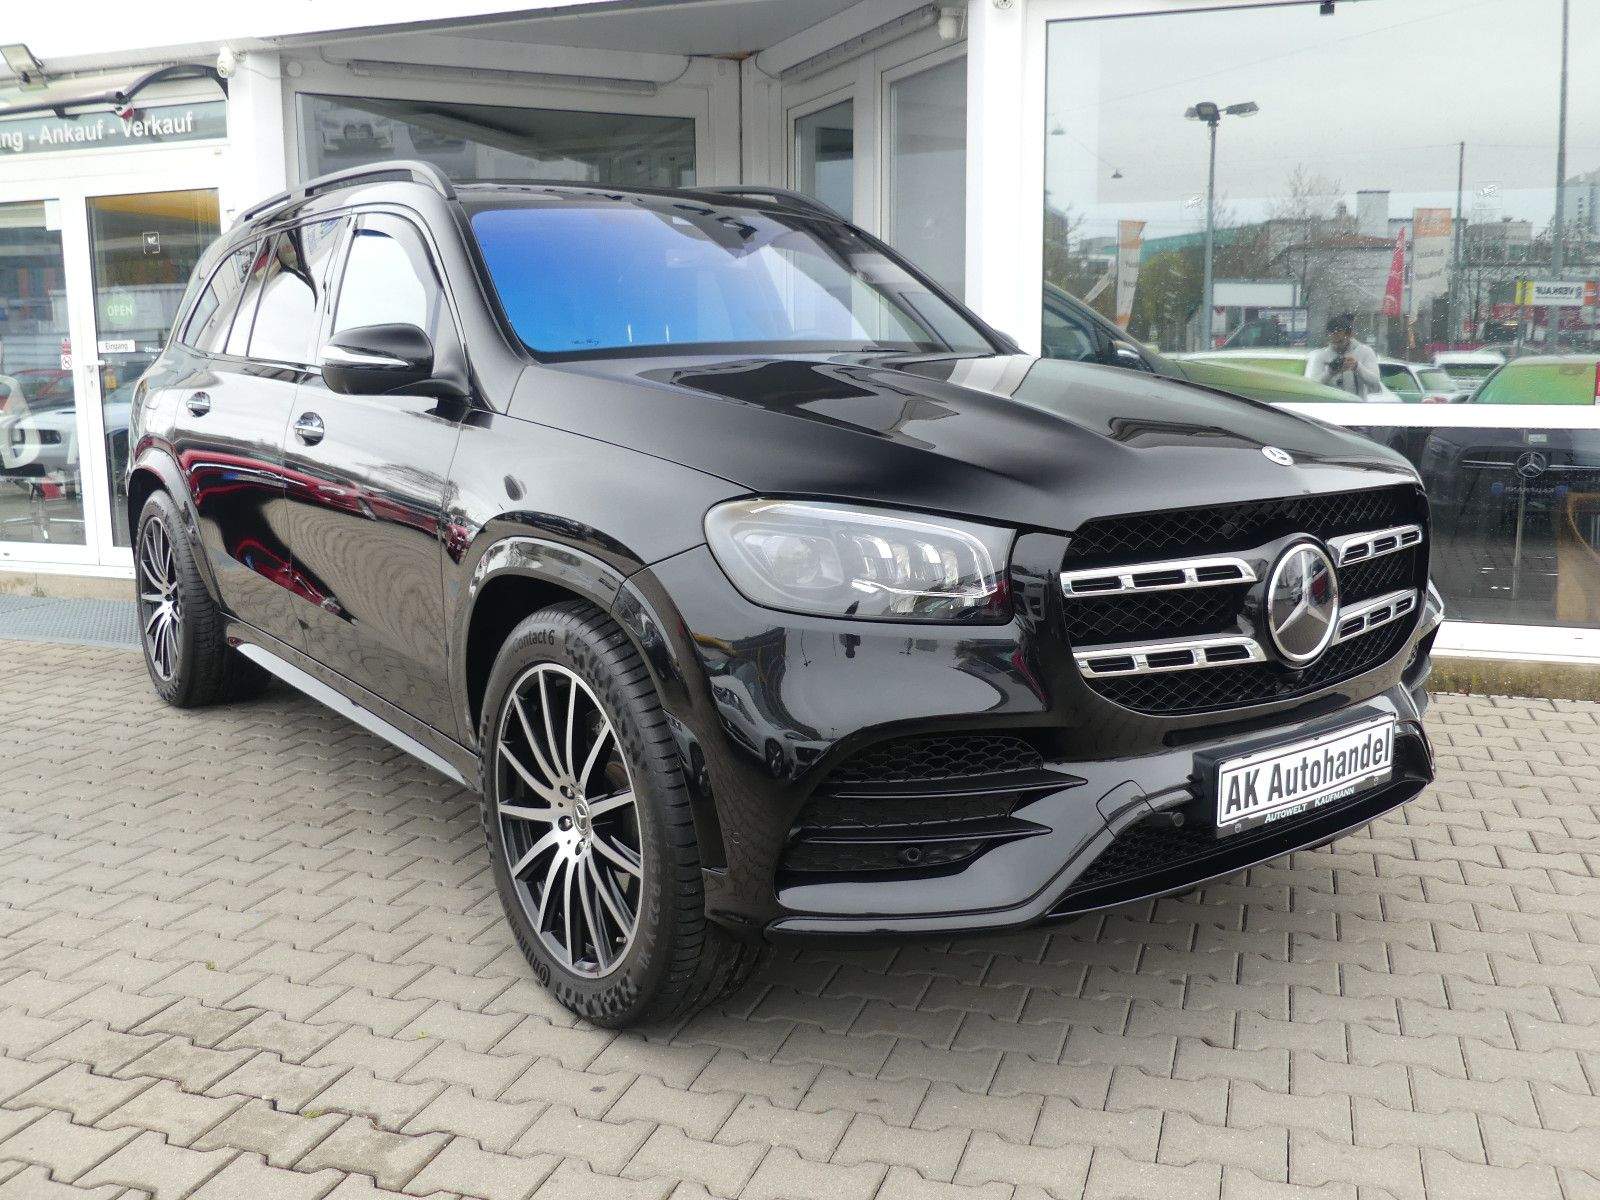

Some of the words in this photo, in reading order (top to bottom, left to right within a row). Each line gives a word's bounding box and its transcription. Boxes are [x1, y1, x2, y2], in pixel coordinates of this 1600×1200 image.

[0, 132, 24, 151] ng
[38, 119, 104, 145] Ankauf
[120, 111, 193, 138] Verkauf
[107, 303, 133, 317] OPEN
[1225, 768, 1260, 815] AK
[1267, 728, 1390, 801] Autohandel
[1265, 802, 1308, 824] AUTOWELT
[1314, 786, 1355, 807] KAUFMANN
